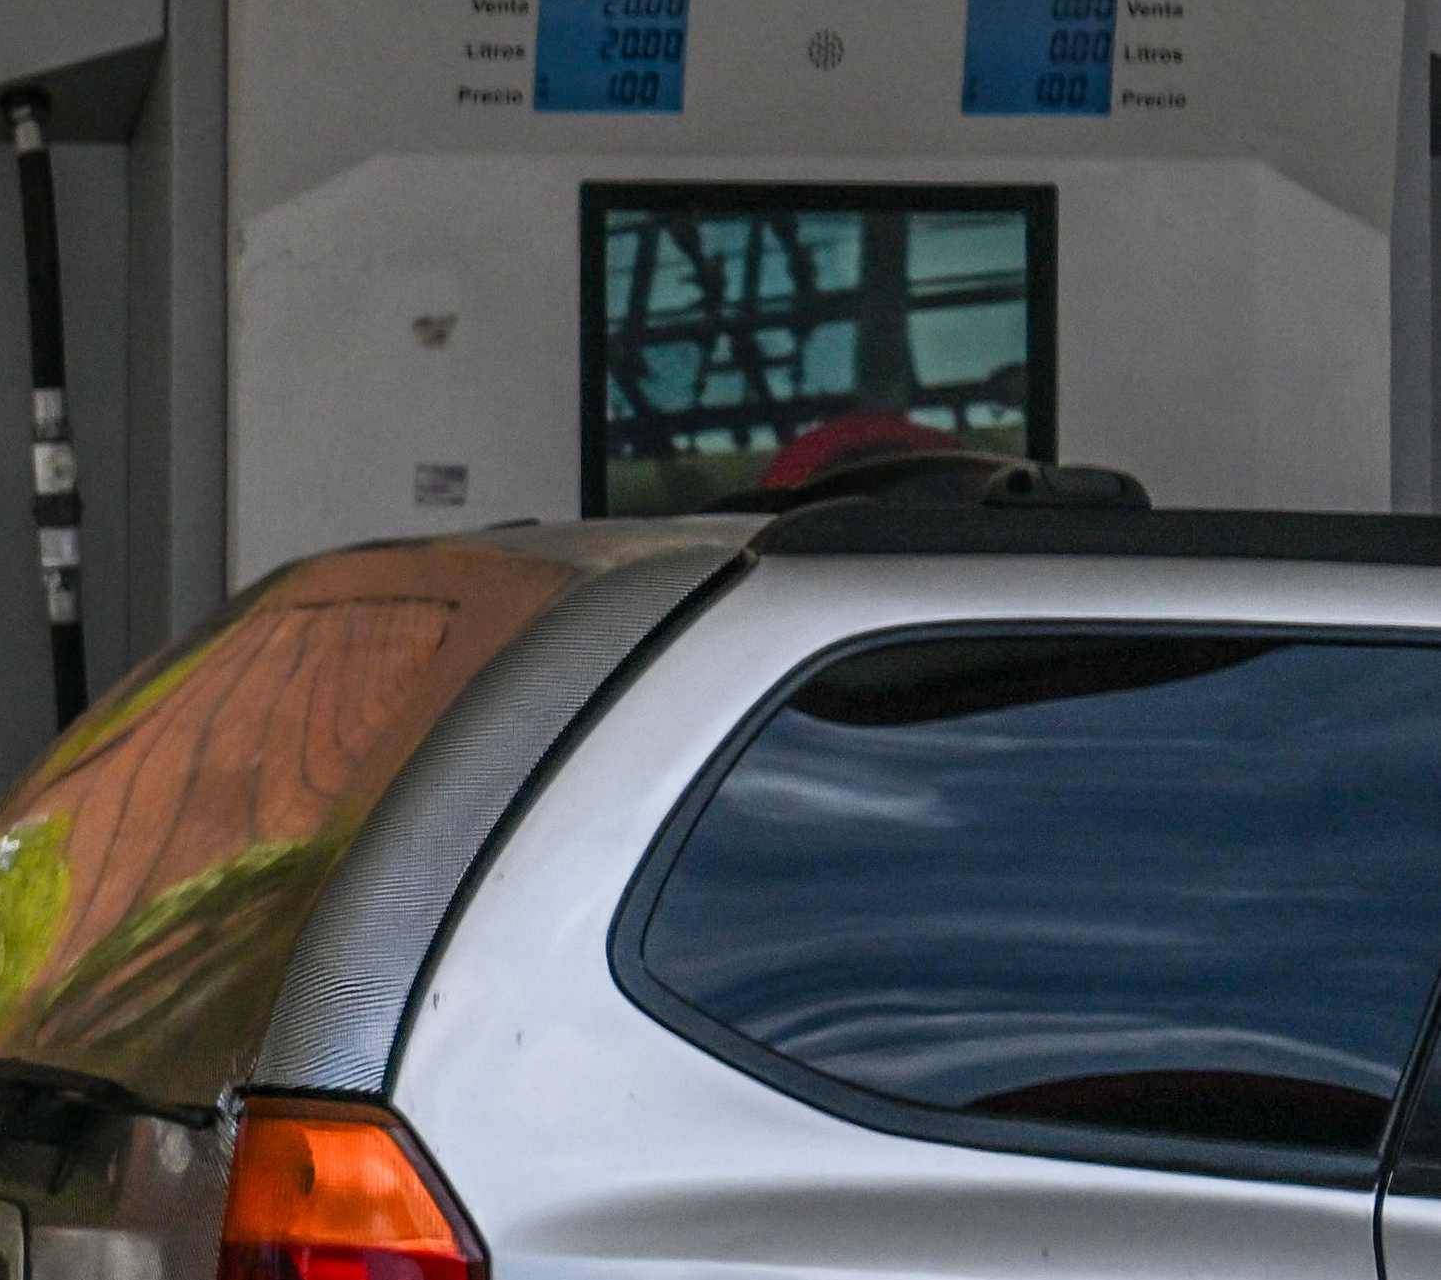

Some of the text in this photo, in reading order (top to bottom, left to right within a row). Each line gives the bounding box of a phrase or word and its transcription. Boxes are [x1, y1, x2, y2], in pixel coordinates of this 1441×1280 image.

[1127, 0, 1183, 17] Venta
[465, 43, 526, 60] Litros
[1124, 45, 1183, 63] Litros
[458, 85, 524, 105] Precio
[1121, 89, 1186, 109] Precio
